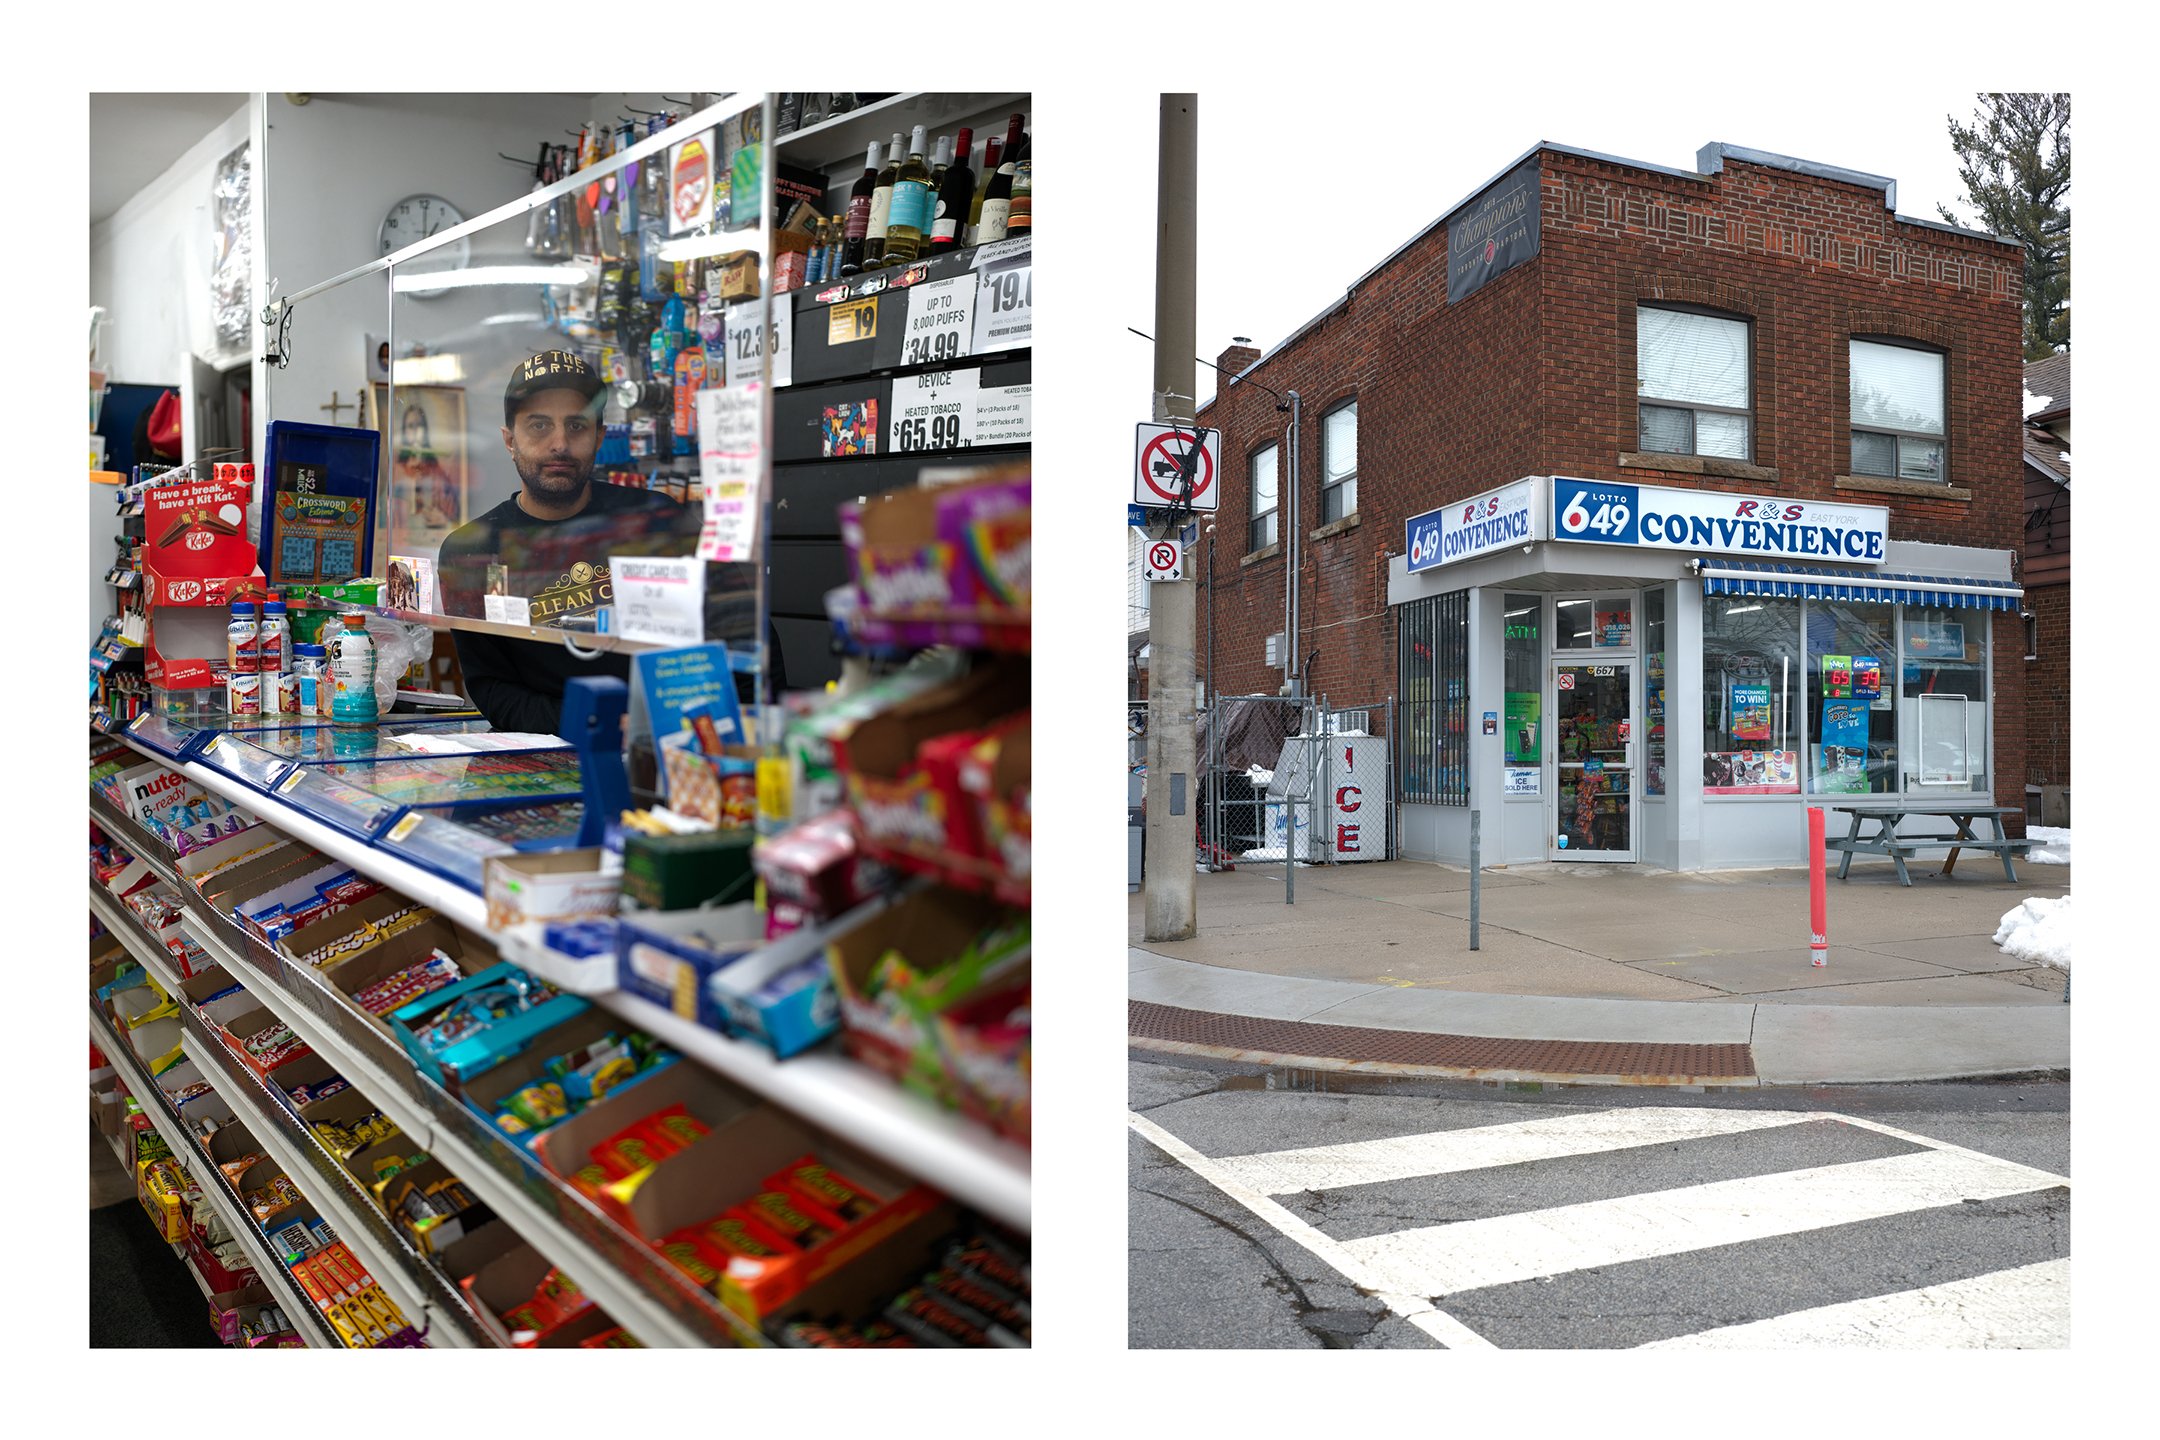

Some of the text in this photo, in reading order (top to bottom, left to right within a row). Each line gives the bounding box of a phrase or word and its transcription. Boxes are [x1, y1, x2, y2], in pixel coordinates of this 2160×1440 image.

[1454, 190, 1533, 253] Champions
[1457, 226, 1527, 276] TORONTO RAPTORS
[927, 295, 952, 311] UP TO
[854, 306, 875, 337] 19
[913, 309, 965, 332] 8,000 PUFFS
[523, 351, 584, 370] WE THE
[918, 371, 952, 389] DEVICE
[904, 402, 962, 417] HEATED TOBACCO
[153, 489, 179, 500] Have
[191, 484, 225, 495] break,
[1593, 493, 1627, 503] LOTTO
[159, 499, 185, 510] have
[187, 498, 194, 506] a
[196, 493, 212, 504] Kit
[297, 496, 347, 512] CROSSWORD
[1128, 512, 1140, 520] AVE
[1463, 505, 1475, 525] R
[1475, 501, 1487, 520] &
[1487, 497, 1499, 517] S
[1561, 491, 1631, 537] 649
[1735, 501, 1859, 525] R & S EAST YORK
[1422, 521, 1438, 532] LOTTO
[1444, 508, 1528, 558] CONVENIENCE
[1640, 512, 1883, 559] CONVENIENCE
[1411, 527, 1439, 565] 649
[528, 584, 614, 618] CLEAN C
[1505, 625, 1537, 640] ATM
[1727, 655, 1776, 671] OPEN
[1832, 670, 1850, 685] 65
[1861, 671, 1879, 685] 34
[1735, 695, 1767, 704] TO WIN!
[1835, 689, 1840, 697] 8
[141, 786, 187, 819] B-ready
